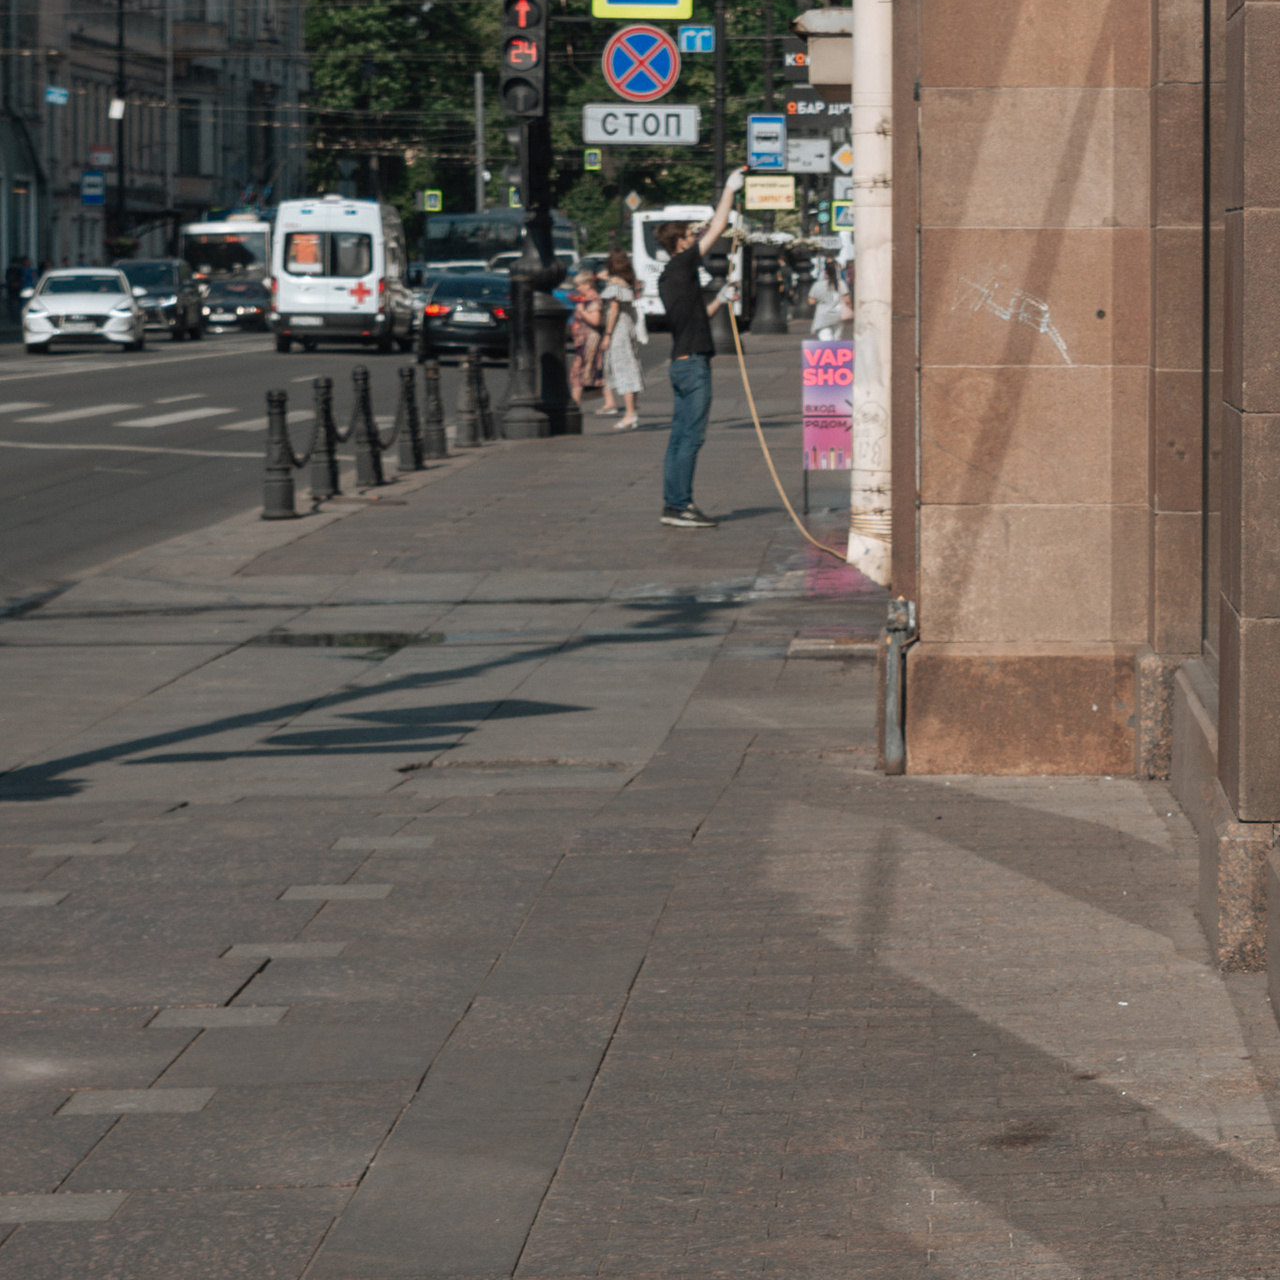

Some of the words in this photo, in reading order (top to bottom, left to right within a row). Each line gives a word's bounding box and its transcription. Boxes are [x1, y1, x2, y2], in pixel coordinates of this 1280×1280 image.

[511, 40, 537, 63] 24
[602, 112, 681, 136] СТОП
[803, 348, 854, 367] VAP
[803, 368, 854, 386] SHO
[805, 404, 836, 414] ВХОД
[805, 420, 848, 430] РЯДОМ
